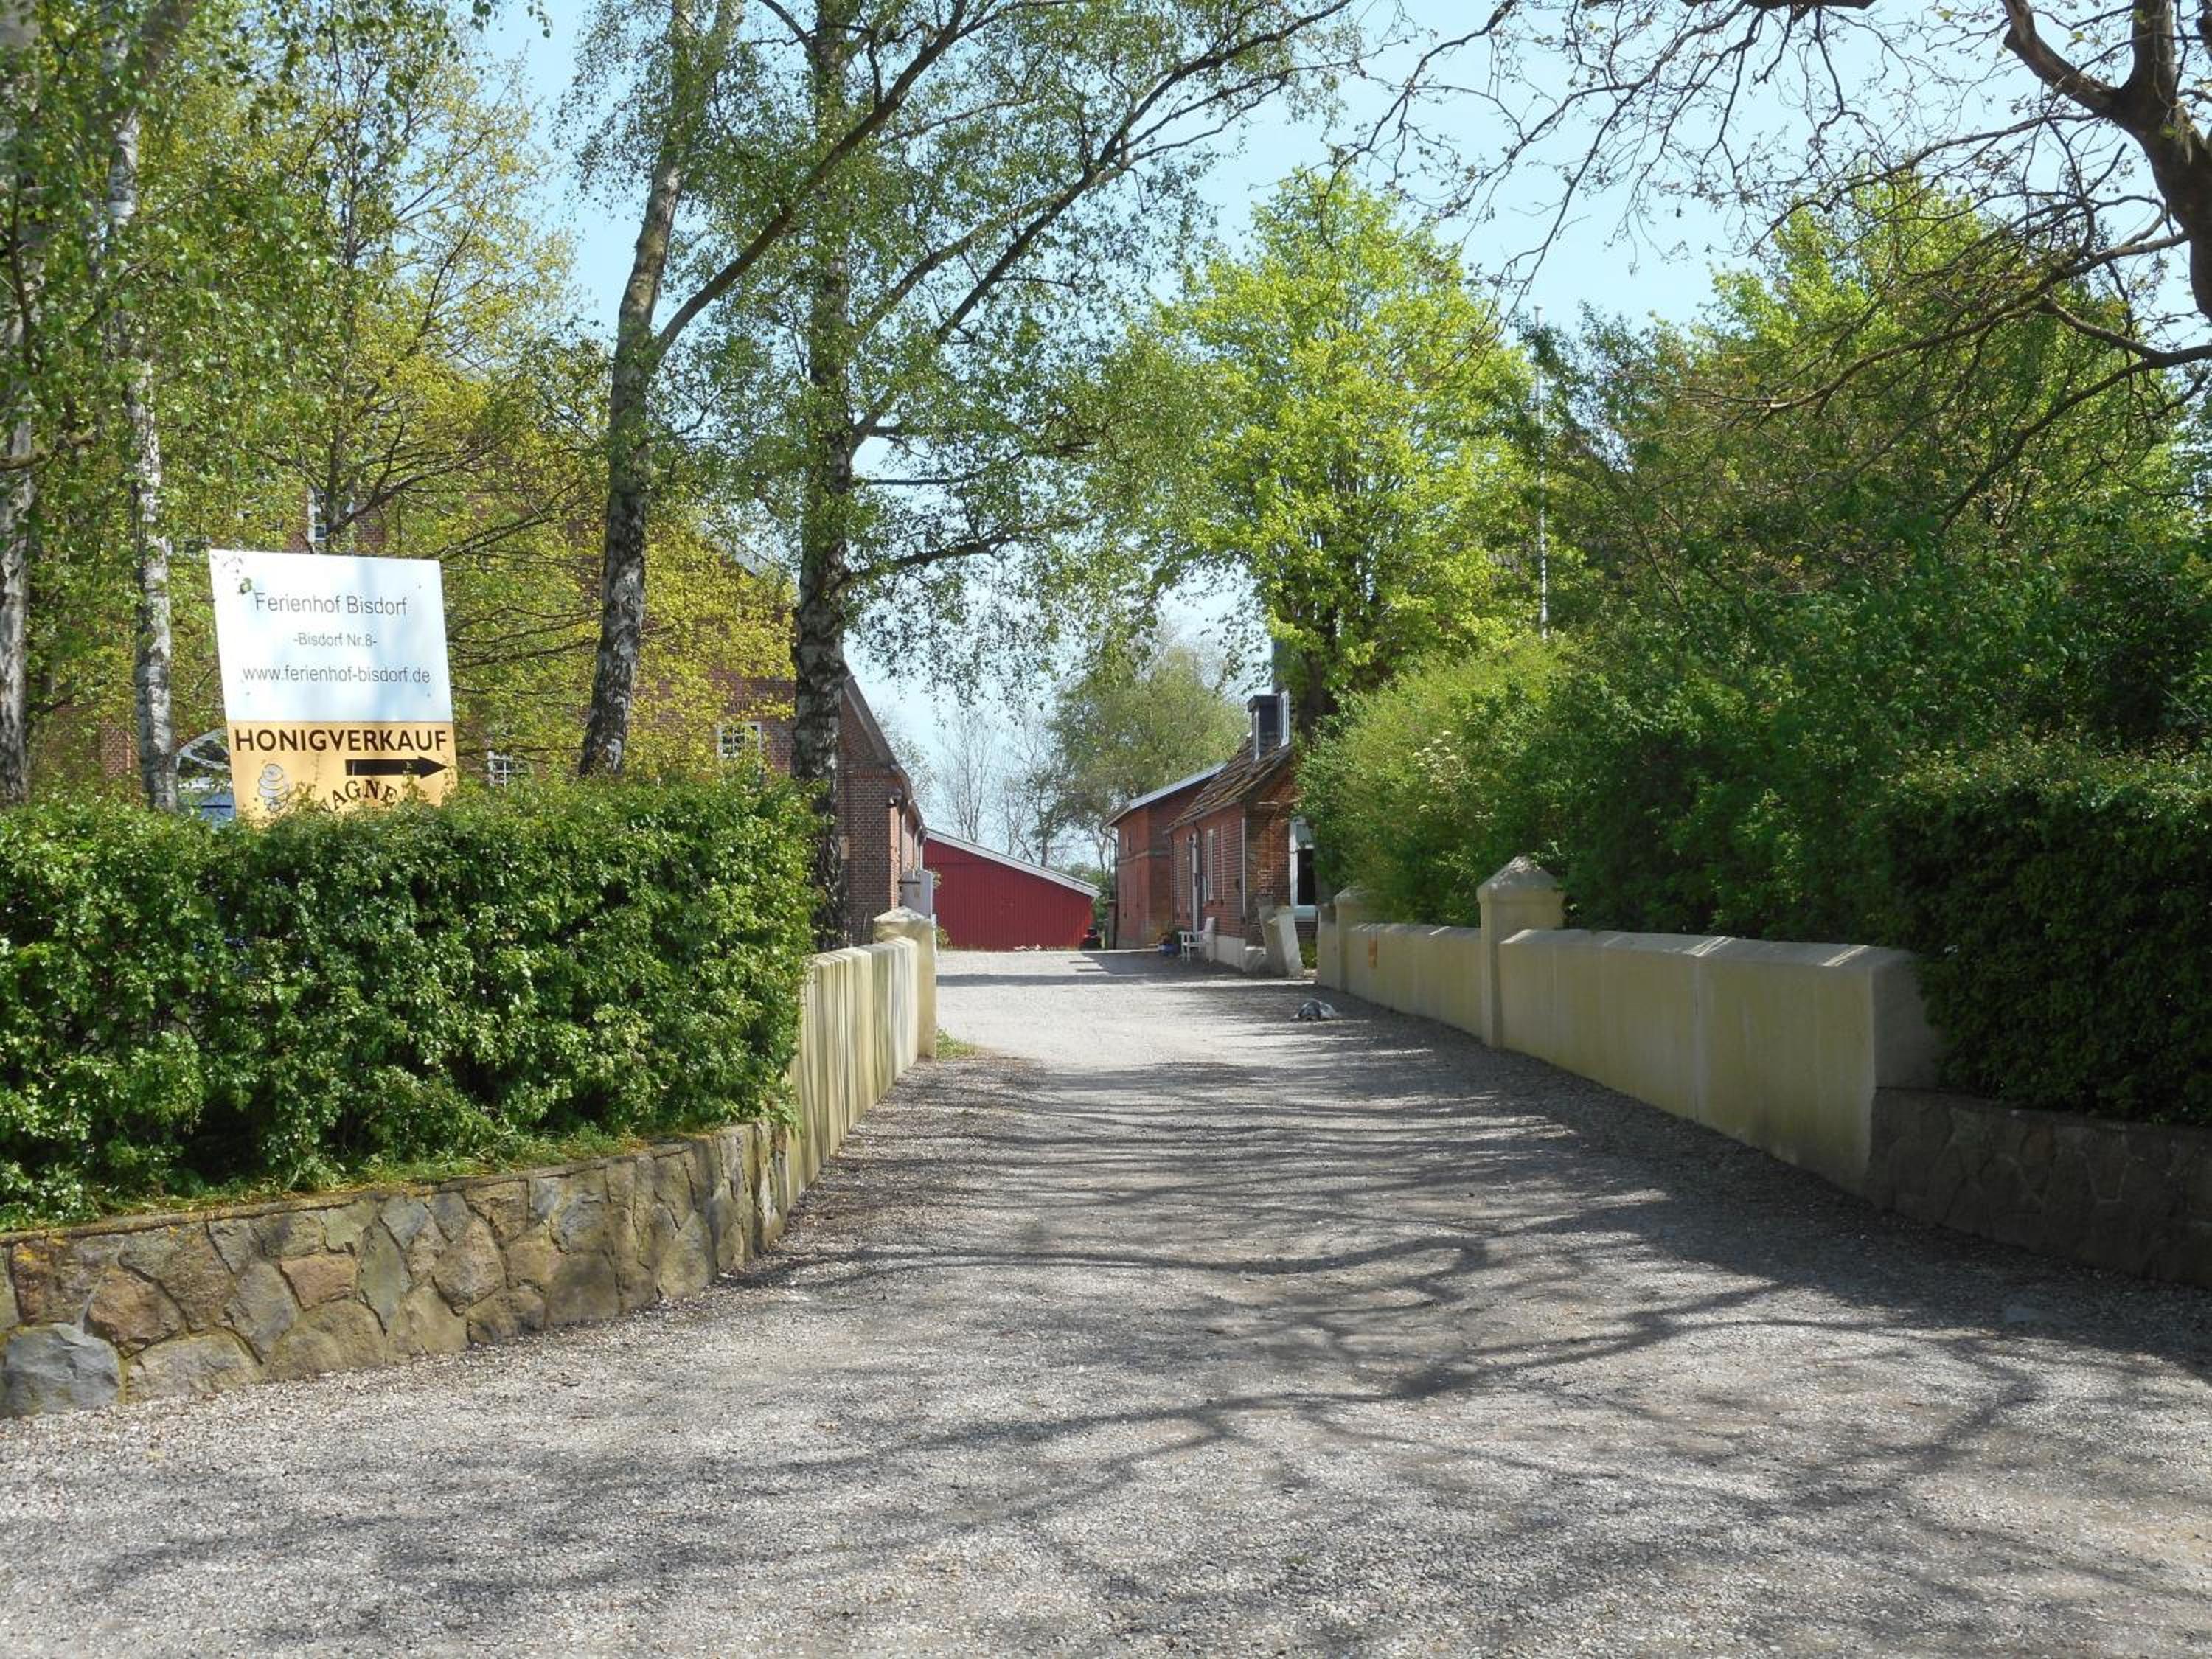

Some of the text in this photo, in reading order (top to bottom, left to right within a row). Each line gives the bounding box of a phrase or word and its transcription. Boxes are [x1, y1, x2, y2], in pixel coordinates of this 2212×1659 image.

[254, 592, 407, 616] Ferienhof Bisdorf
[293, 632, 378, 647] -Bisdorf Nr.8-
[243, 666, 431, 683] www.ferienhof-bisdorf.de
[234, 729, 447, 751] HONIGVERKAUF
